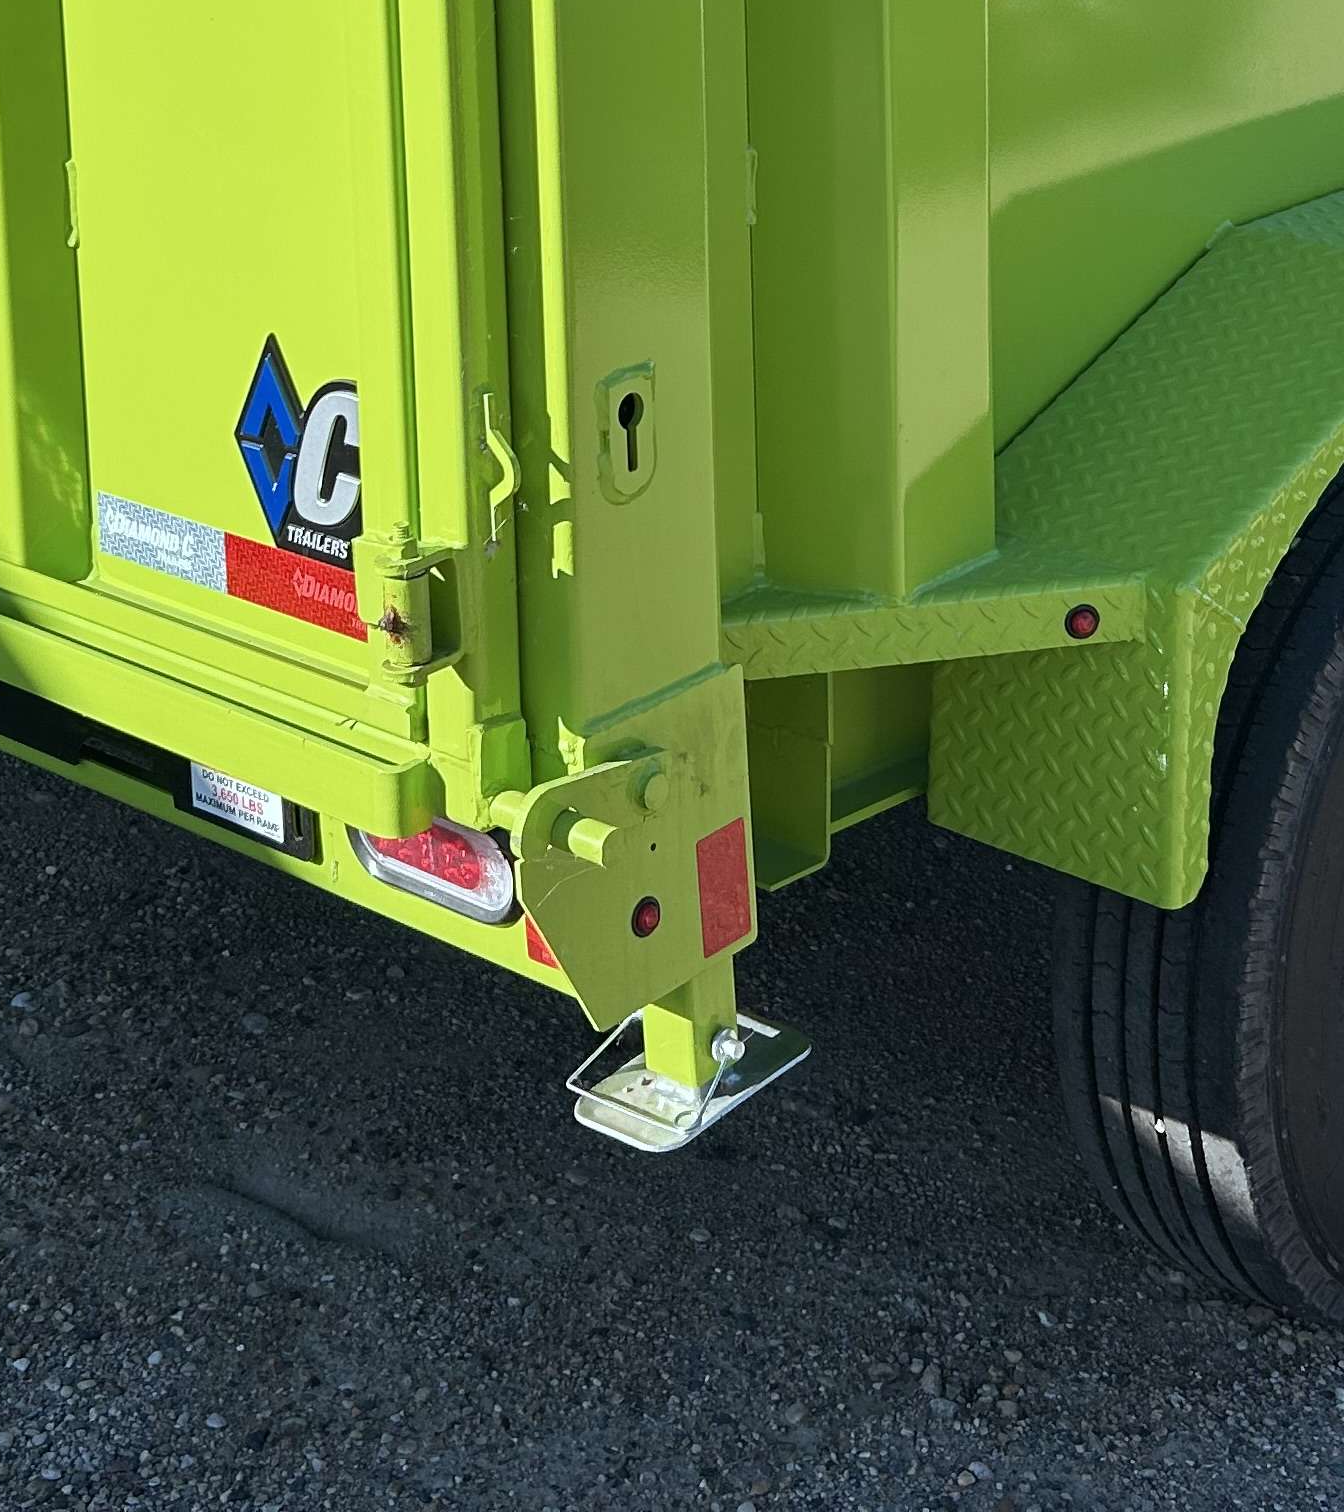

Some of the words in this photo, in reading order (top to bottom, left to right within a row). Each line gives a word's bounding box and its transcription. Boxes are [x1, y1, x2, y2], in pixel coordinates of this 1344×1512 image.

[287, 524, 350, 560] TRAILERS
[302, 574, 359, 614] DIAMO
[202, 769, 214, 782] DO
[216, 775, 234, 789] NOT
[236, 782, 270, 803] EXCEED
[211, 784, 239, 805] 3,650
[241, 795, 264, 815] LBS
[196, 791, 236, 817] MAXIMUM
[238, 809, 255, 823] PER
